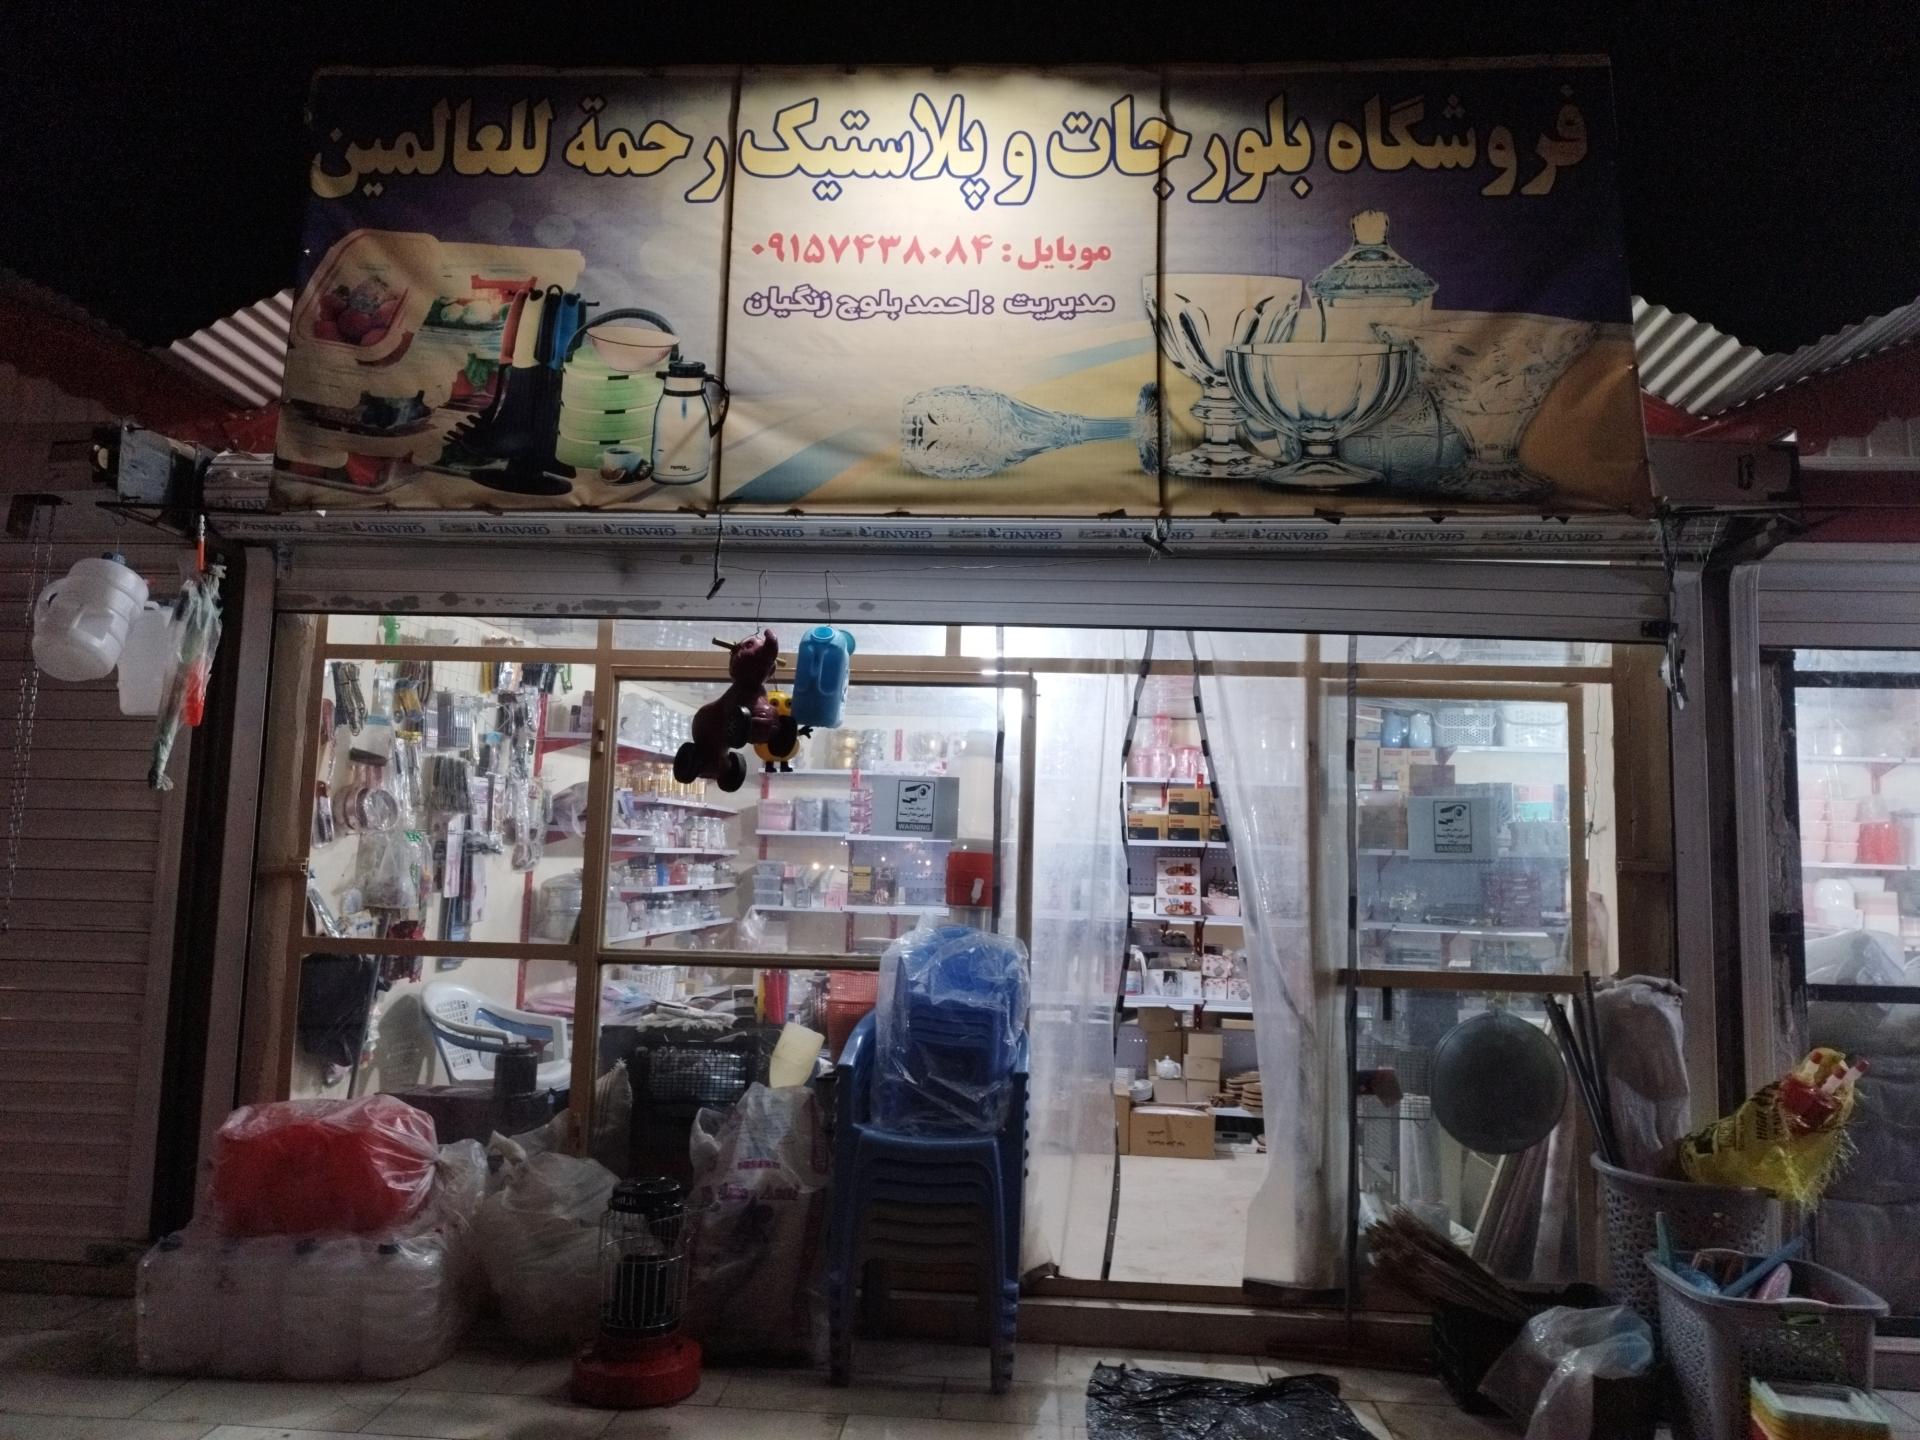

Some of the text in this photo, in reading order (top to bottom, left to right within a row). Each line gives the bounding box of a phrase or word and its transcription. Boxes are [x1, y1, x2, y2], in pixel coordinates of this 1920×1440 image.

[310, 96, 556, 199] للعالمین
[738, 93, 989, 211] پلاستیک
[993, 130, 1038, 206] و
[1326, 84, 1589, 196] فروشگاه
[751, 232, 994, 265] ۰۹۱۵۷۴۳۸۰۸۴
[1003, 293, 1116, 320] مدیریت
[1134, 529, 1195, 540] GRD
